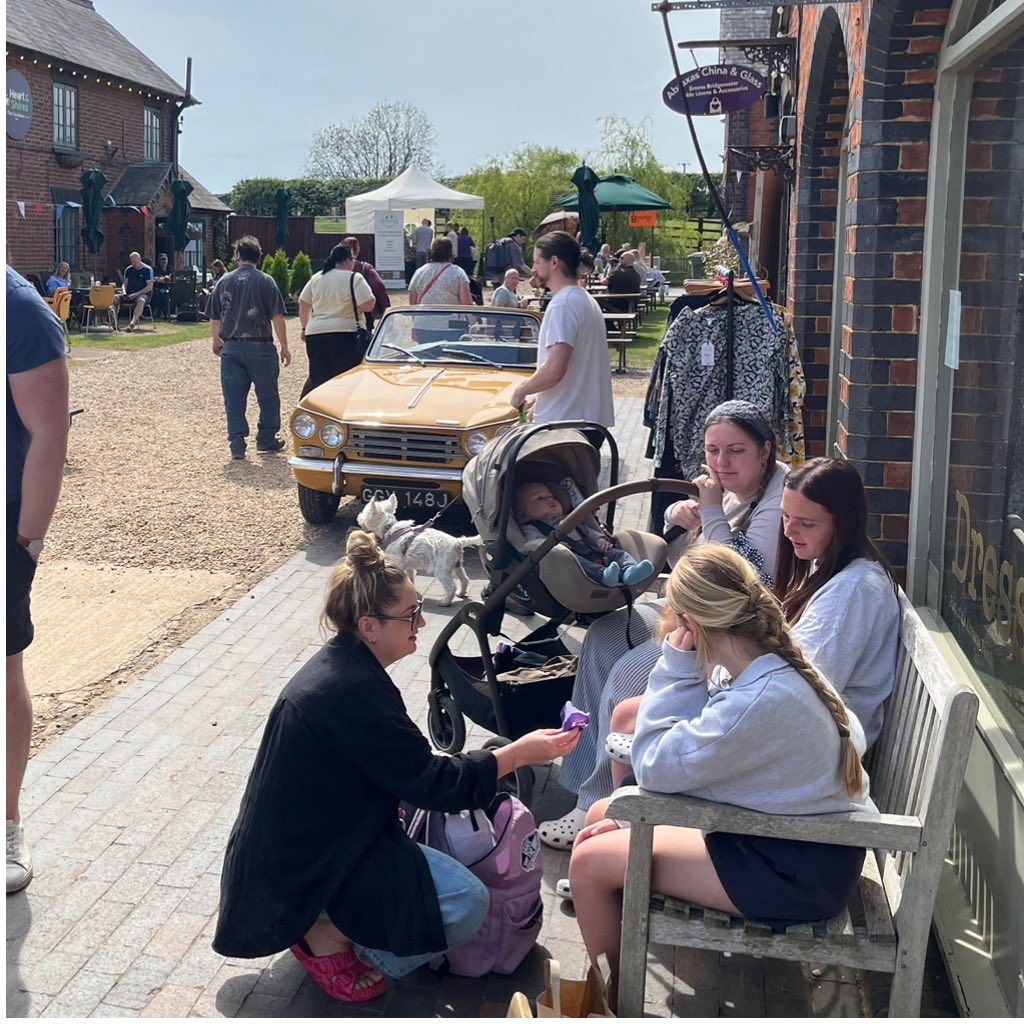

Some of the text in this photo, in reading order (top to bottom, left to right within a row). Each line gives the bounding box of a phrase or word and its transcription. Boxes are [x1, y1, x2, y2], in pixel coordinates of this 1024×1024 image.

[666, 66, 764, 100] Abxas China & Glass
[405, 490, 450, 509] 148J
